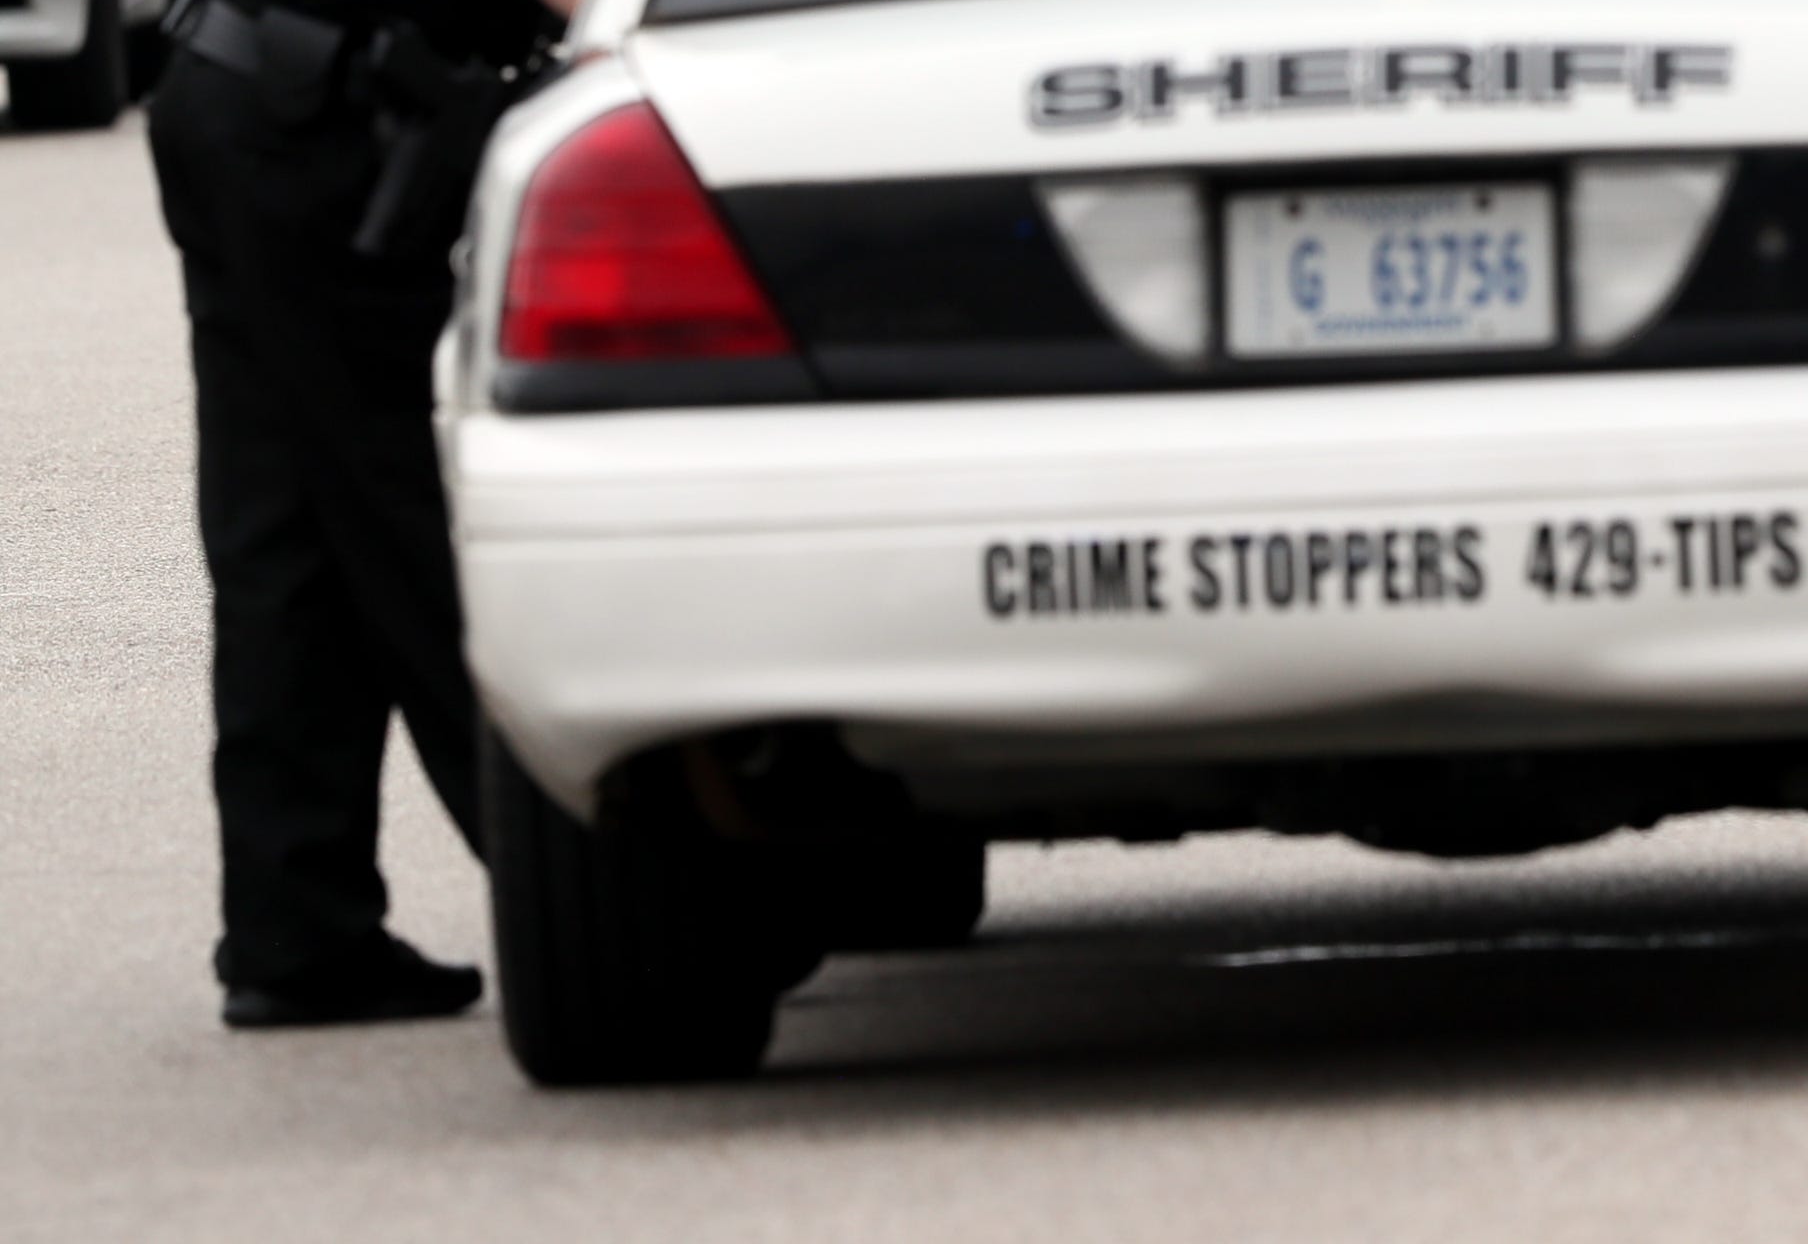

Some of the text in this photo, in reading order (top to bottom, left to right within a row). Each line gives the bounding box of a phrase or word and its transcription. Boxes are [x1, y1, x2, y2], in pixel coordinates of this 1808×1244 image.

[1027, 44, 1733, 131] SHERIFF
[1288, 230, 1530, 313] G 63756
[982, 510, 1802, 618] CRIME STOPPERS 429-TIPS
